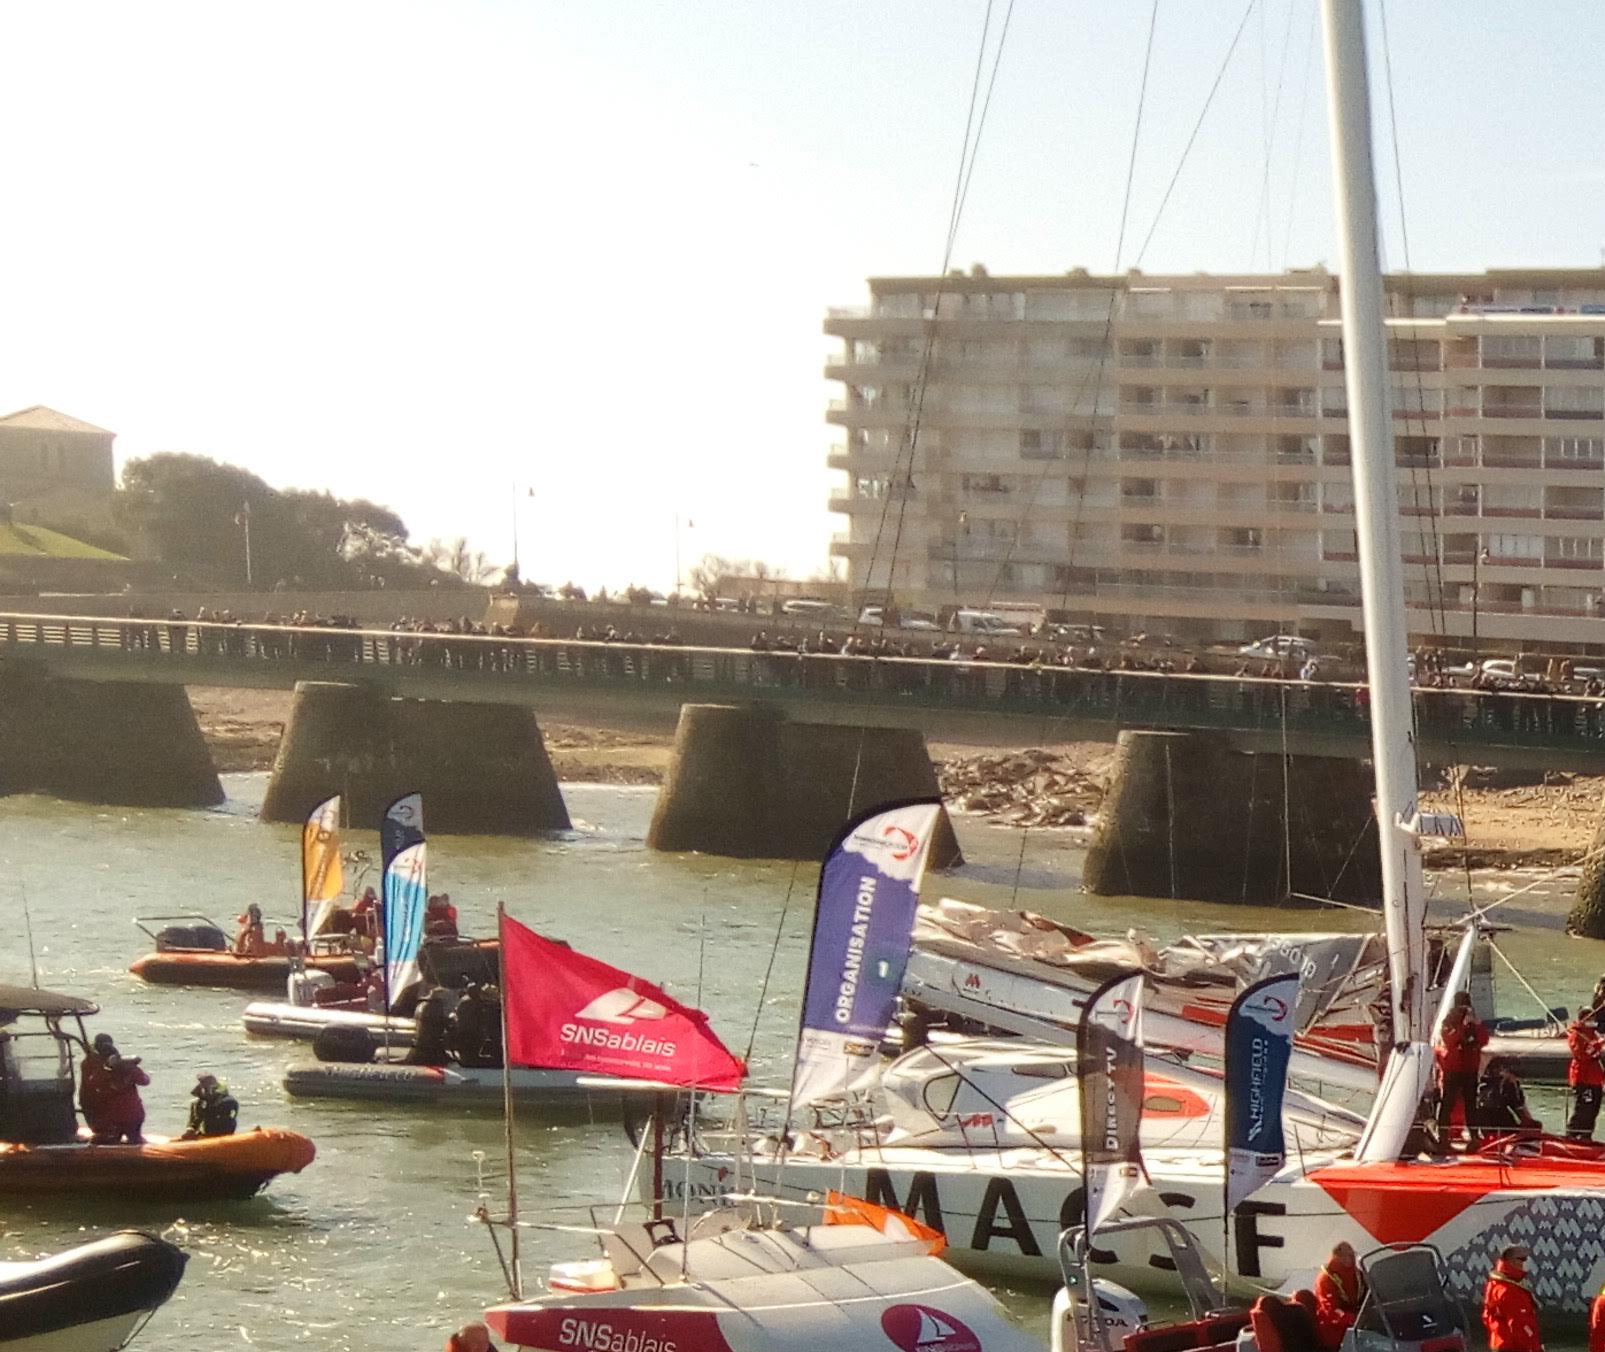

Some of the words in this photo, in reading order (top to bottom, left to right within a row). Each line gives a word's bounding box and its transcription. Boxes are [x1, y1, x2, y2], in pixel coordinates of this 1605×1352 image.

[835, 876, 877, 1024] ORGANISATION
[560, 1023, 676, 1057] SNSablais
[1250, 1038, 1264, 1120] HIGHFIELD
